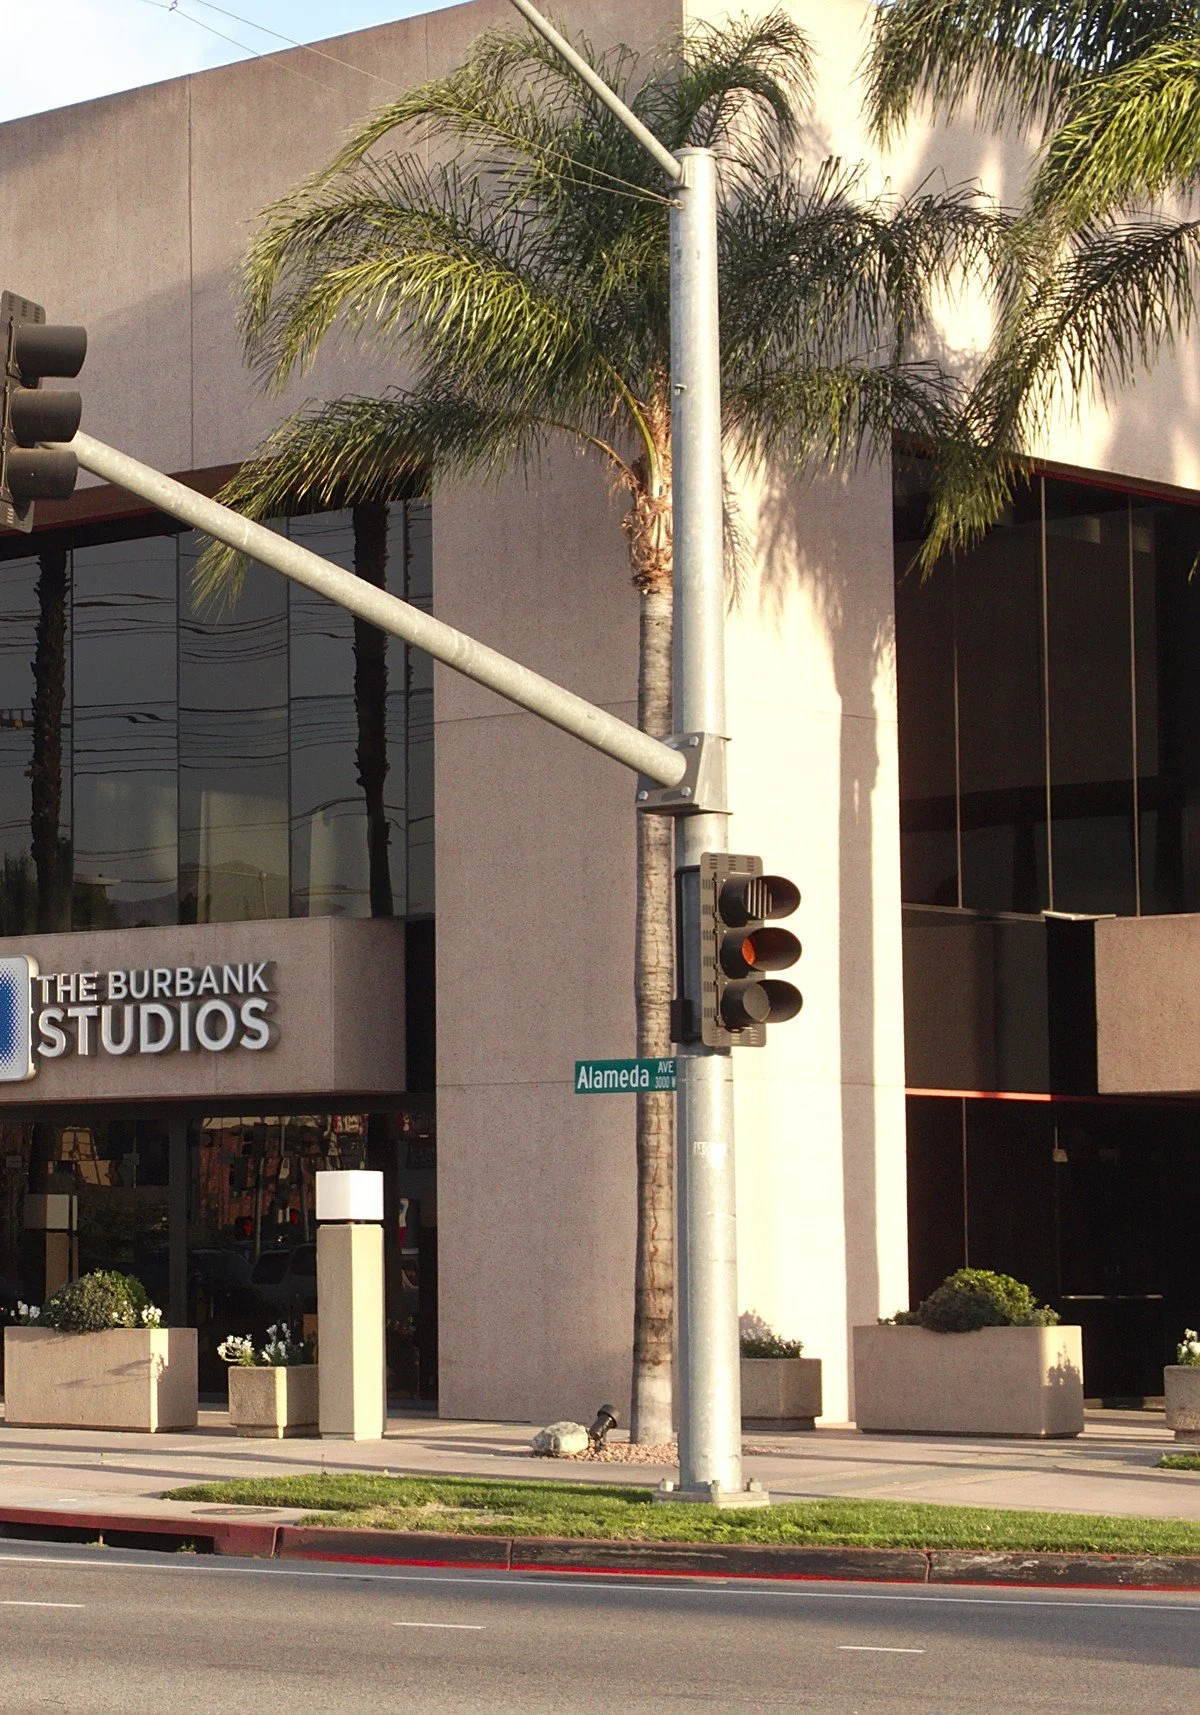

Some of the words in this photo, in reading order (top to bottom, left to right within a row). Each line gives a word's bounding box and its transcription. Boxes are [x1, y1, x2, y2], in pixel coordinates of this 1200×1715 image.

[36, 971, 99, 1004] THE
[108, 960, 270, 1000] BURBANK
[37, 997, 270, 1058] STUDIOS
[577, 1064, 650, 1089] Alameda
[657, 1060, 674, 1074] AVE
